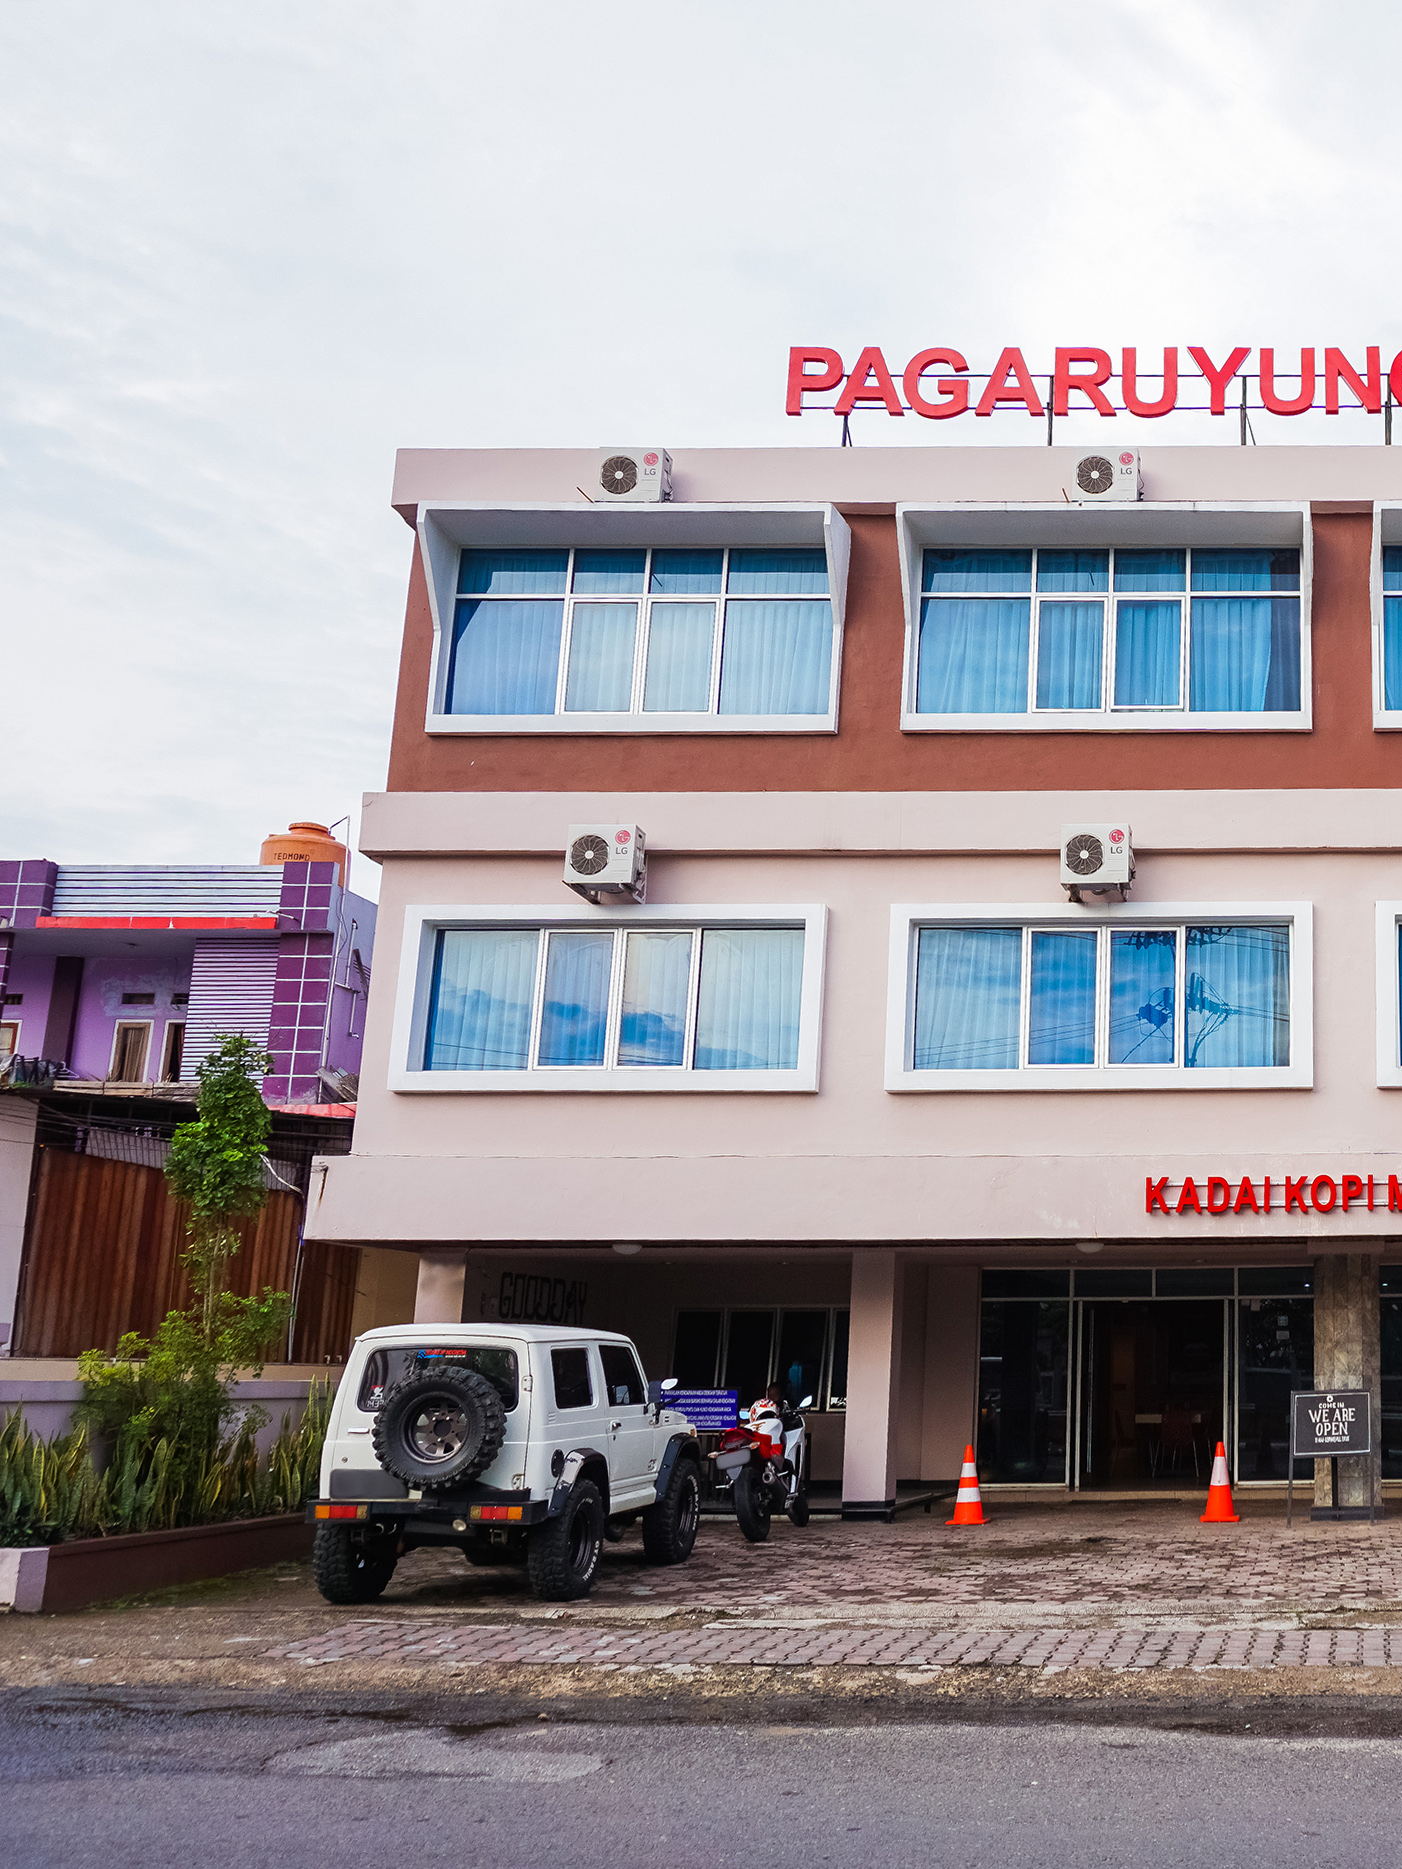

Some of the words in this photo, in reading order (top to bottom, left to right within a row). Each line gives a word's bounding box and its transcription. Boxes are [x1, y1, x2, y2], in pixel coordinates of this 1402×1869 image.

[644, 467, 656, 475] LG
[615, 846, 627, 854] LG
[1110, 846, 1122, 854] LG
[1145, 1176, 1272, 1213] KADAI
[1284, 1174, 1375, 1212] KOPI
[1308, 1409, 1329, 1423] WE
[1333, 1408, 1356, 1422] ARE
[1315, 1422, 1349, 1436] OPEN
